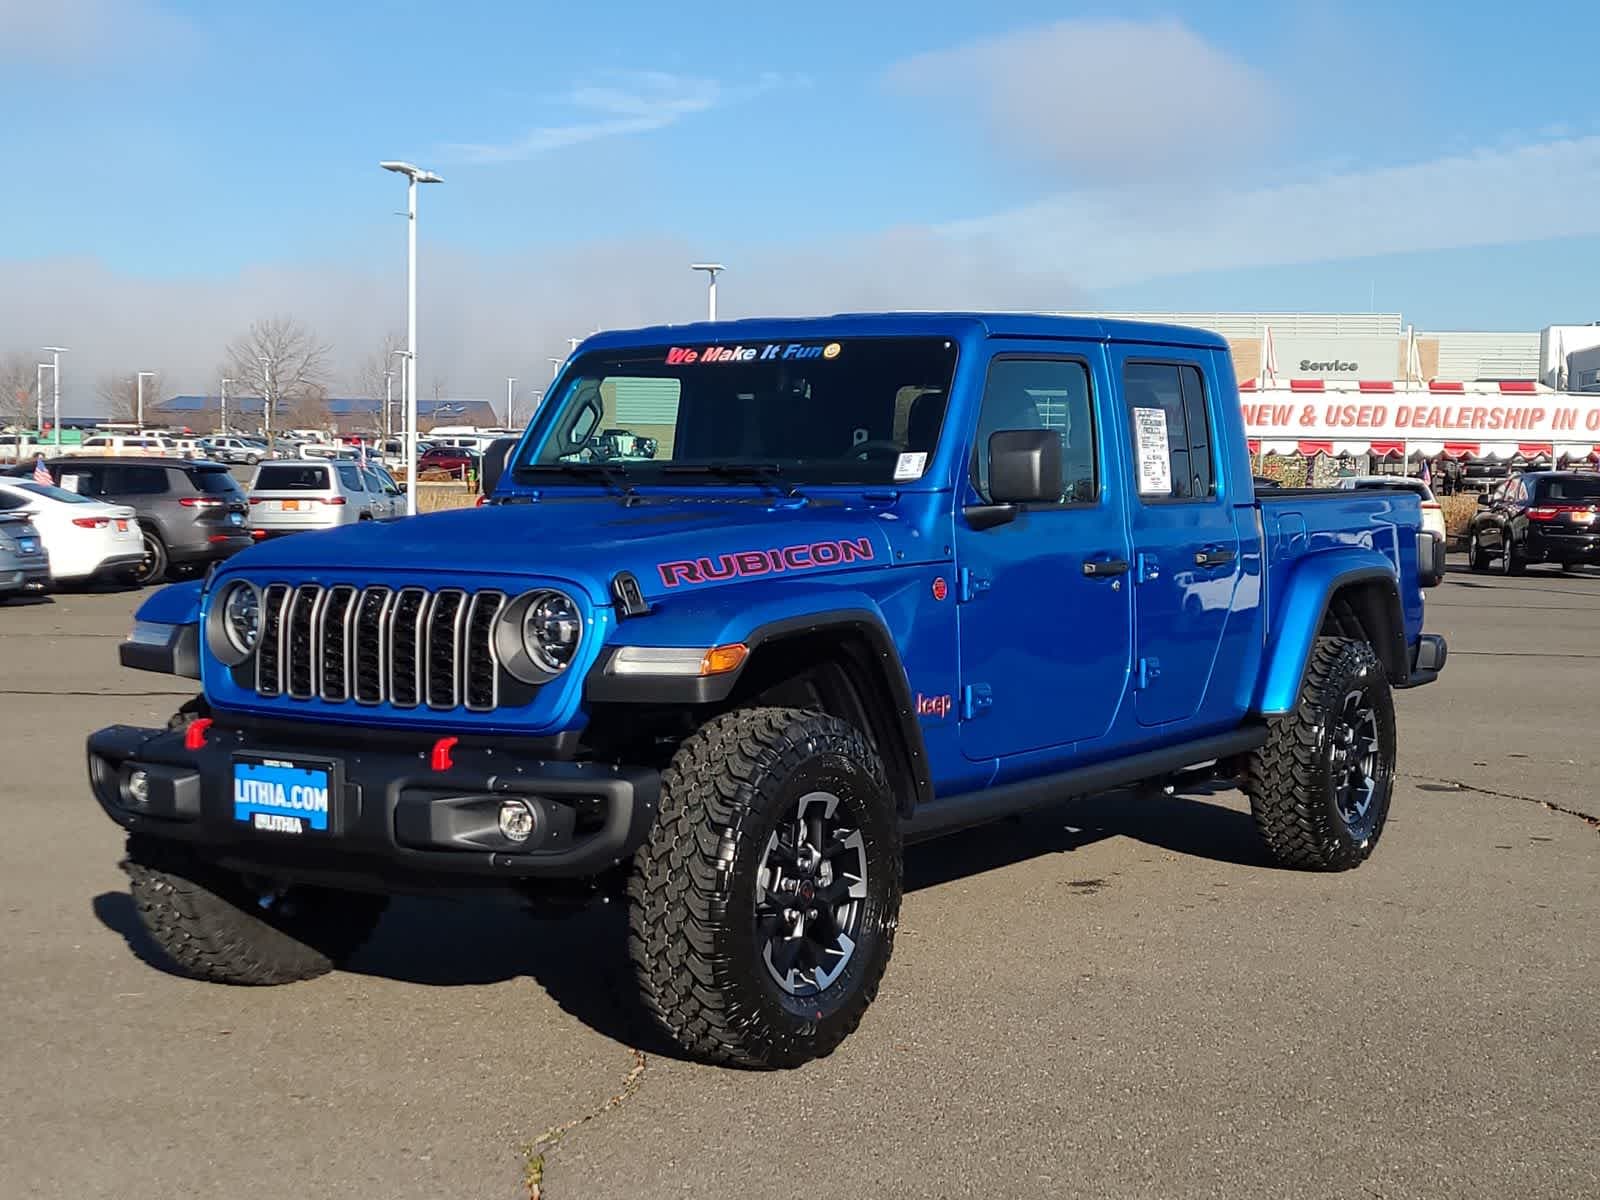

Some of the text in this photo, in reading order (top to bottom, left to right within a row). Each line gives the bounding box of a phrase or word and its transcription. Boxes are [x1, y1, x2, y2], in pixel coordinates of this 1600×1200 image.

[665, 344, 824, 365] We Make It Fun
[1299, 359, 1359, 372] Service
[1240, 404, 1295, 426] NEW
[1299, 404, 1317, 427] &
[1325, 405, 1388, 428] USED
[1395, 405, 1546, 430] DEALERSHIP
[1551, 407, 1579, 430] IN
[657, 537, 874, 588] RUBICON
[915, 693, 951, 719] Jeep
[234, 777, 328, 813] LITHIA.COM
